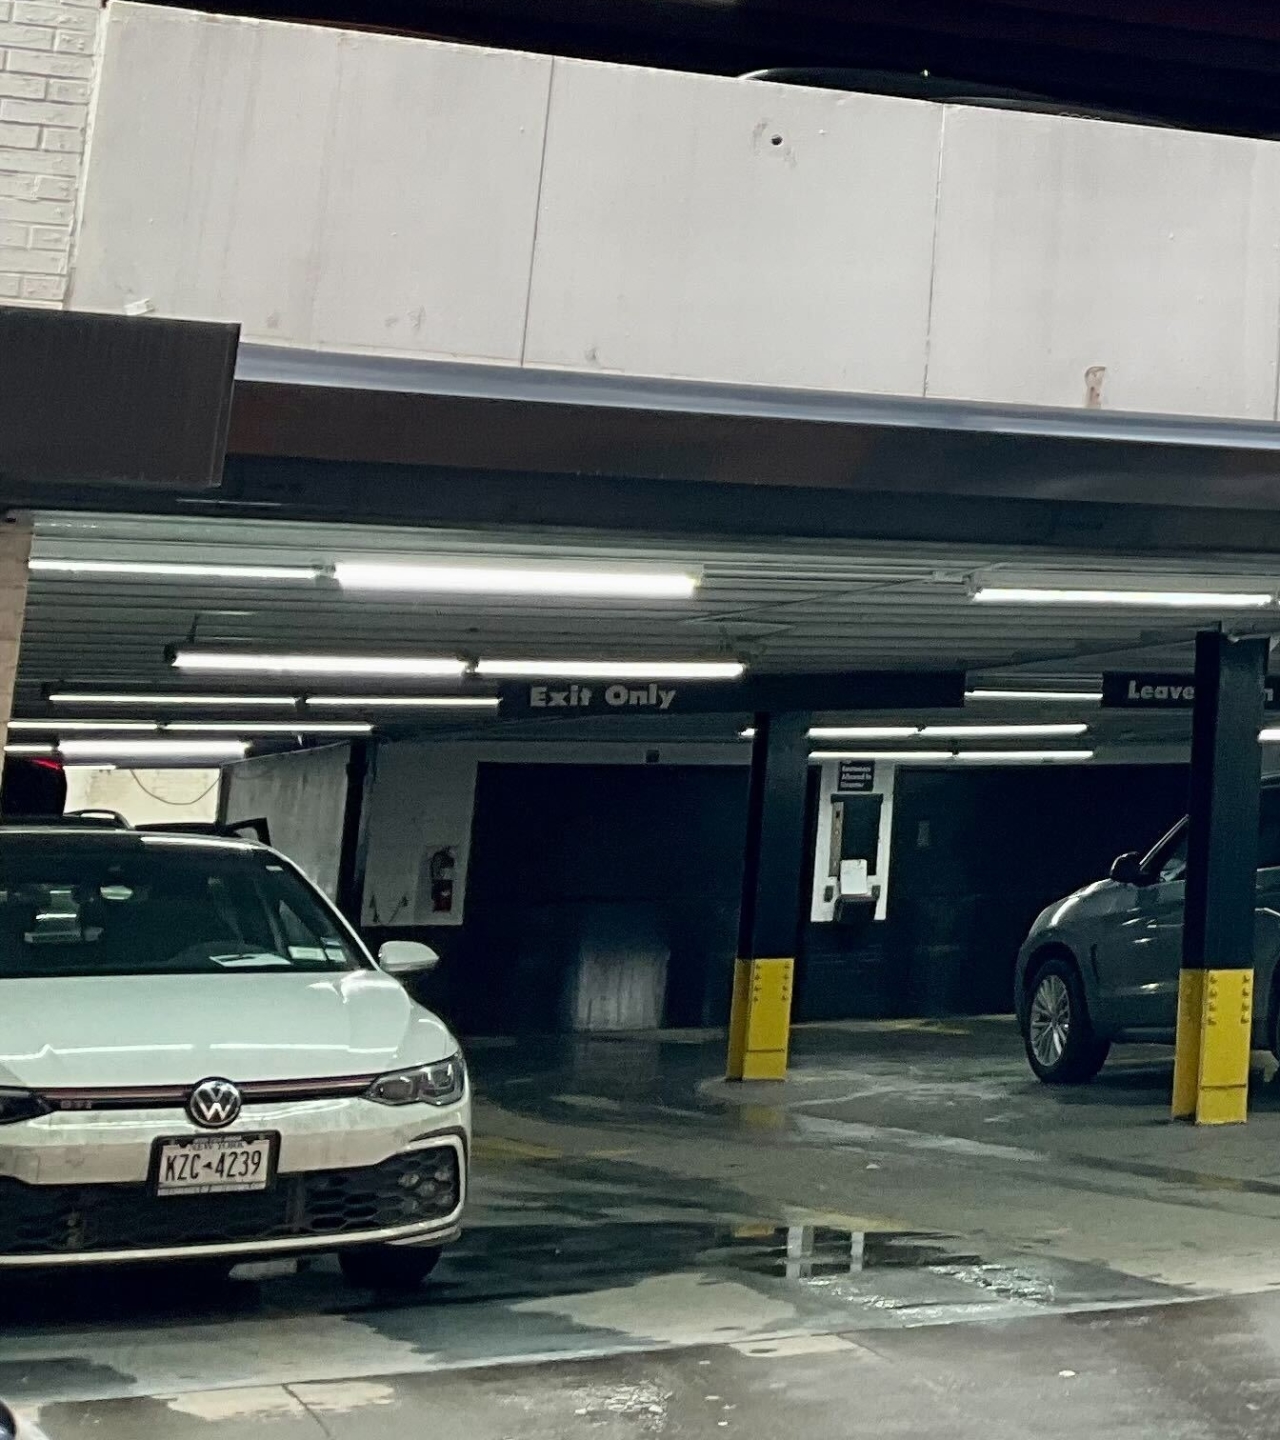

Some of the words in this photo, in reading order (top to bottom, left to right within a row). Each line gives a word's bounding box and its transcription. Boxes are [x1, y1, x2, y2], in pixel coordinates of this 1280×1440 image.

[530, 684, 592, 707] Exit
[605, 683, 676, 710] Only
[1127, 679, 1195, 701] Leave
